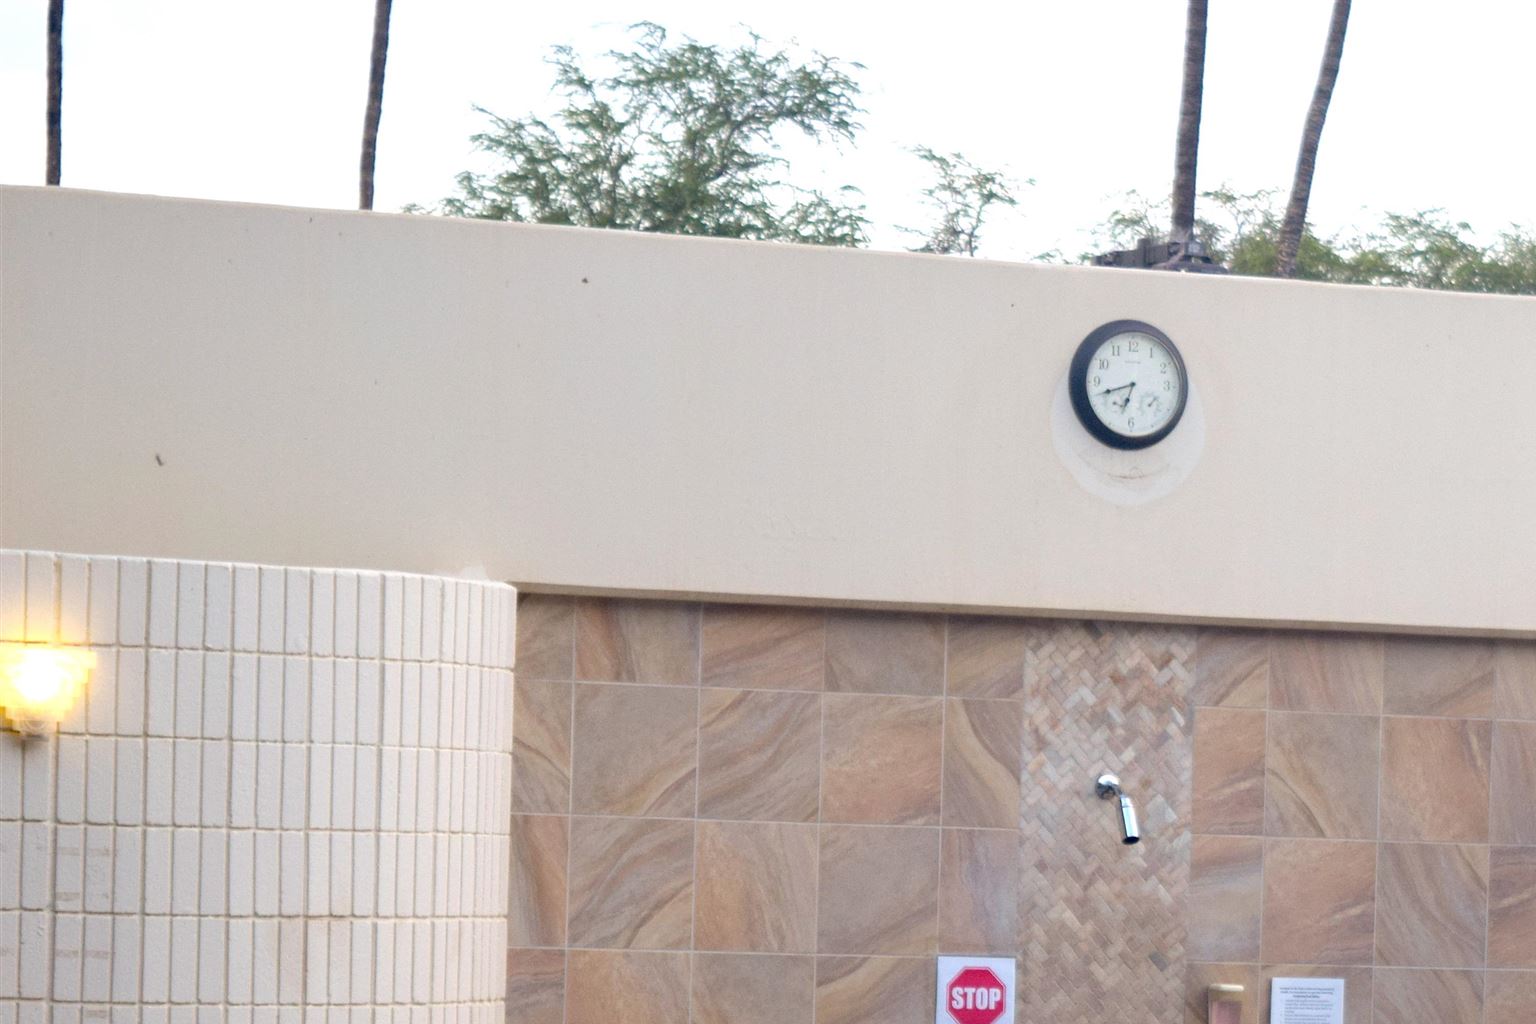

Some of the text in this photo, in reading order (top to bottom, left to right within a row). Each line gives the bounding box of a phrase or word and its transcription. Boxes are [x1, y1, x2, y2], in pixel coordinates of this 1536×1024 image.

[1112, 345, 1120, 356] 11
[1128, 341, 1138, 352] 12
[1148, 348, 1153, 358] 1
[1099, 359, 1108, 369] 10
[1160, 362, 1167, 374] 2
[1094, 376, 1100, 386] 9
[1163, 381, 1170, 391] 3
[1128, 418, 1134, 428] 6
[952, 987, 1001, 1010] STOP
